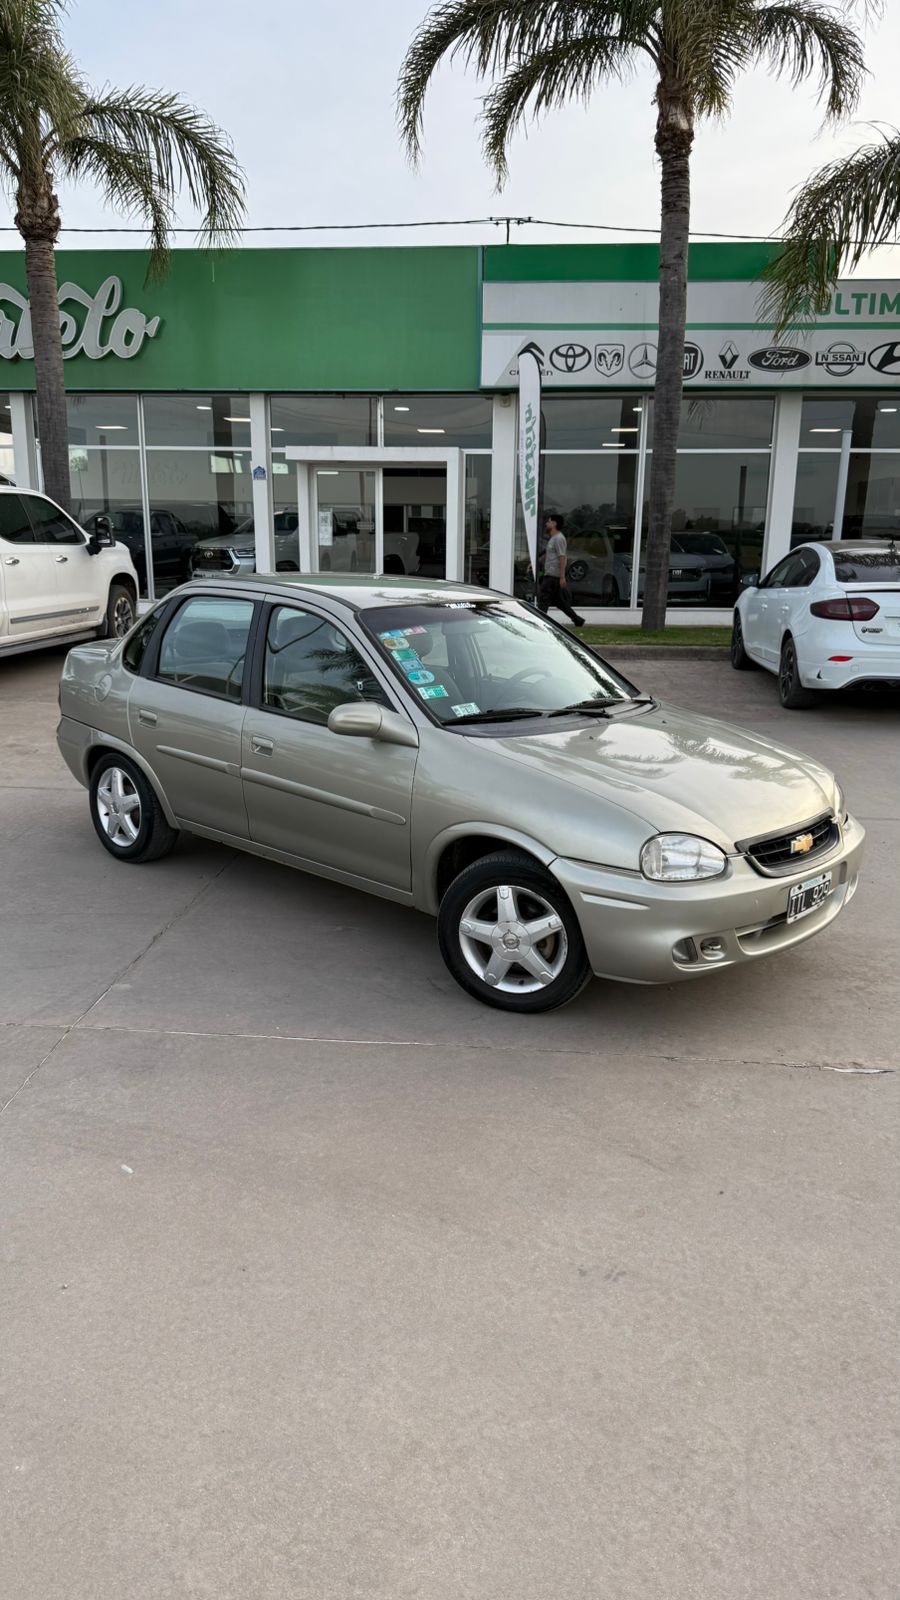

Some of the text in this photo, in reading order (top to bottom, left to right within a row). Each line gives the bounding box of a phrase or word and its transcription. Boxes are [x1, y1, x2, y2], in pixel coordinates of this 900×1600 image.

[761, 350, 799, 366] Ford
[821, 353, 860, 362] NSSAN
[704, 370, 751, 379] RENAULT
[790, 892, 806, 917] ITL
